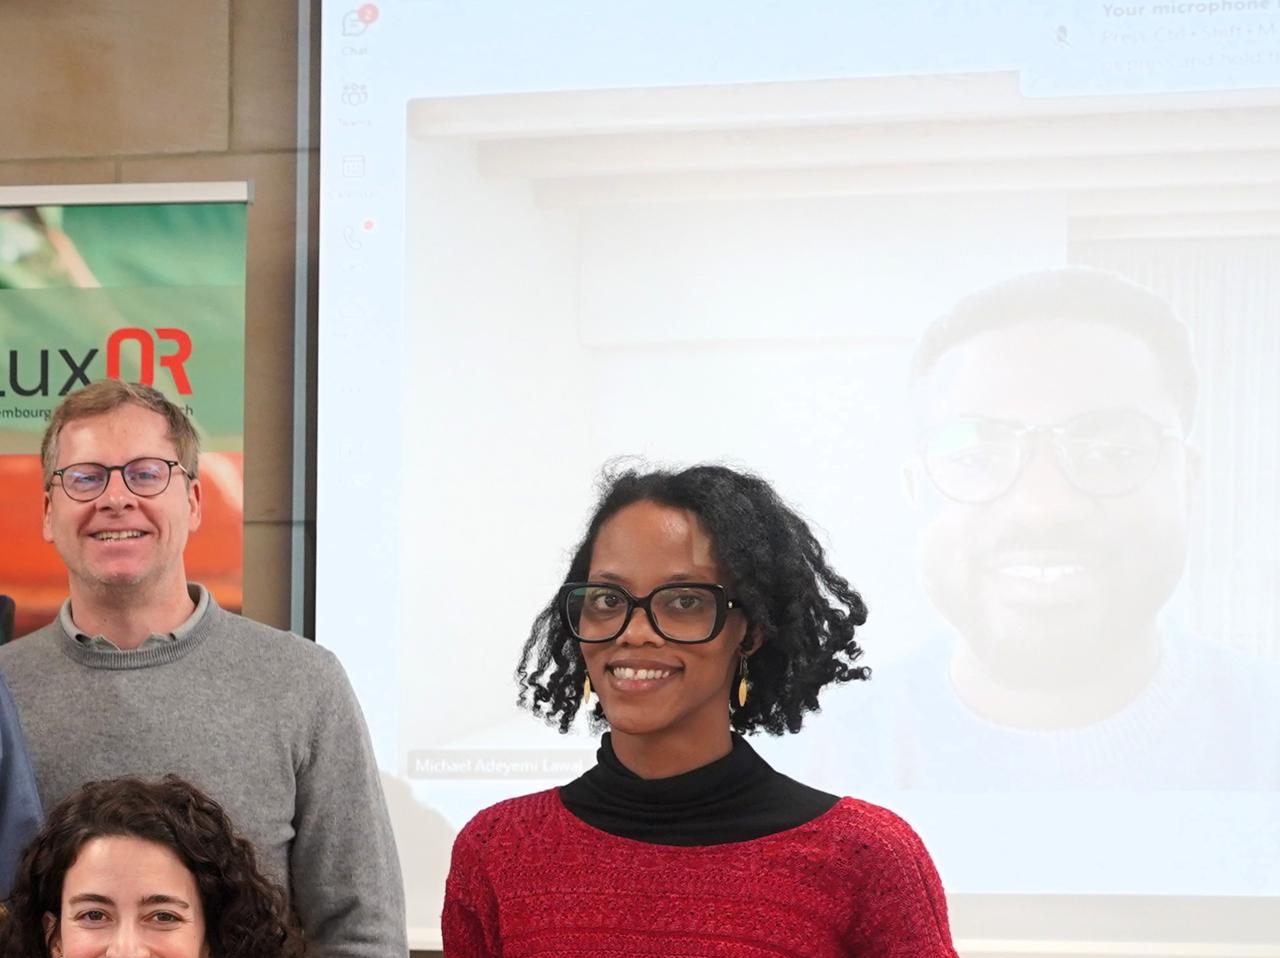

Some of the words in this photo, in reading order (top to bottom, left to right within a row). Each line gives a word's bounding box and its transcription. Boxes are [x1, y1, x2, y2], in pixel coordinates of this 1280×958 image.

[1102, 3, 1145, 17] Your
[1152, 0, 1270, 16] microphone
[341, 46, 368, 56] Chat
[415, 758, 472, 773] Michael
[476, 759, 538, 777] Adeyemi
